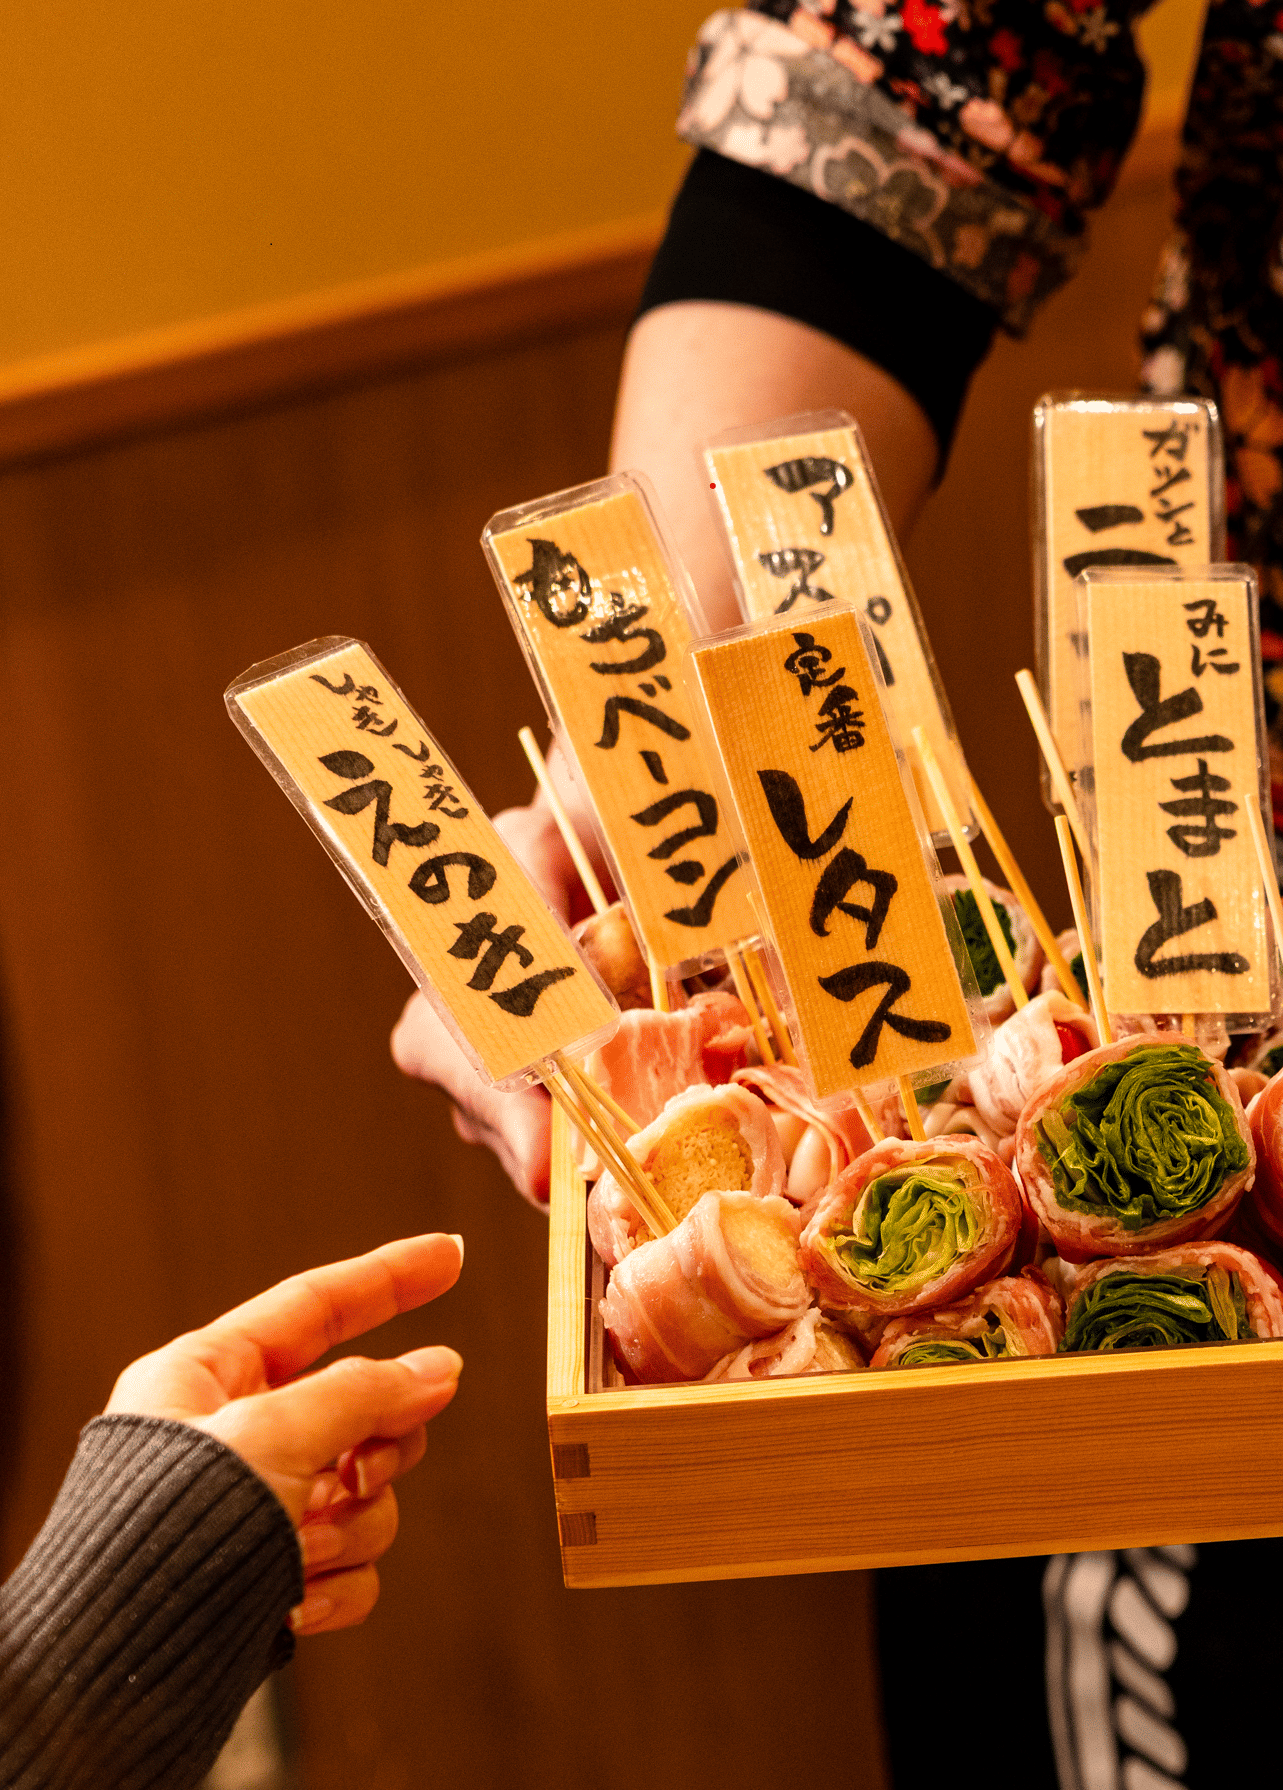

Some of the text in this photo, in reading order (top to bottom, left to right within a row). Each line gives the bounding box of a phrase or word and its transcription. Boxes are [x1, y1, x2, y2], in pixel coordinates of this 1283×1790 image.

[784, 632, 866, 754] 定番
[1183, 598, 1240, 678] みに
[308, 672, 469, 819] しゃきしゃき
[1121, 651, 1251, 980] とまと
[317, 749, 577, 1018] えのき
[756, 769, 952, 1069] レタス
